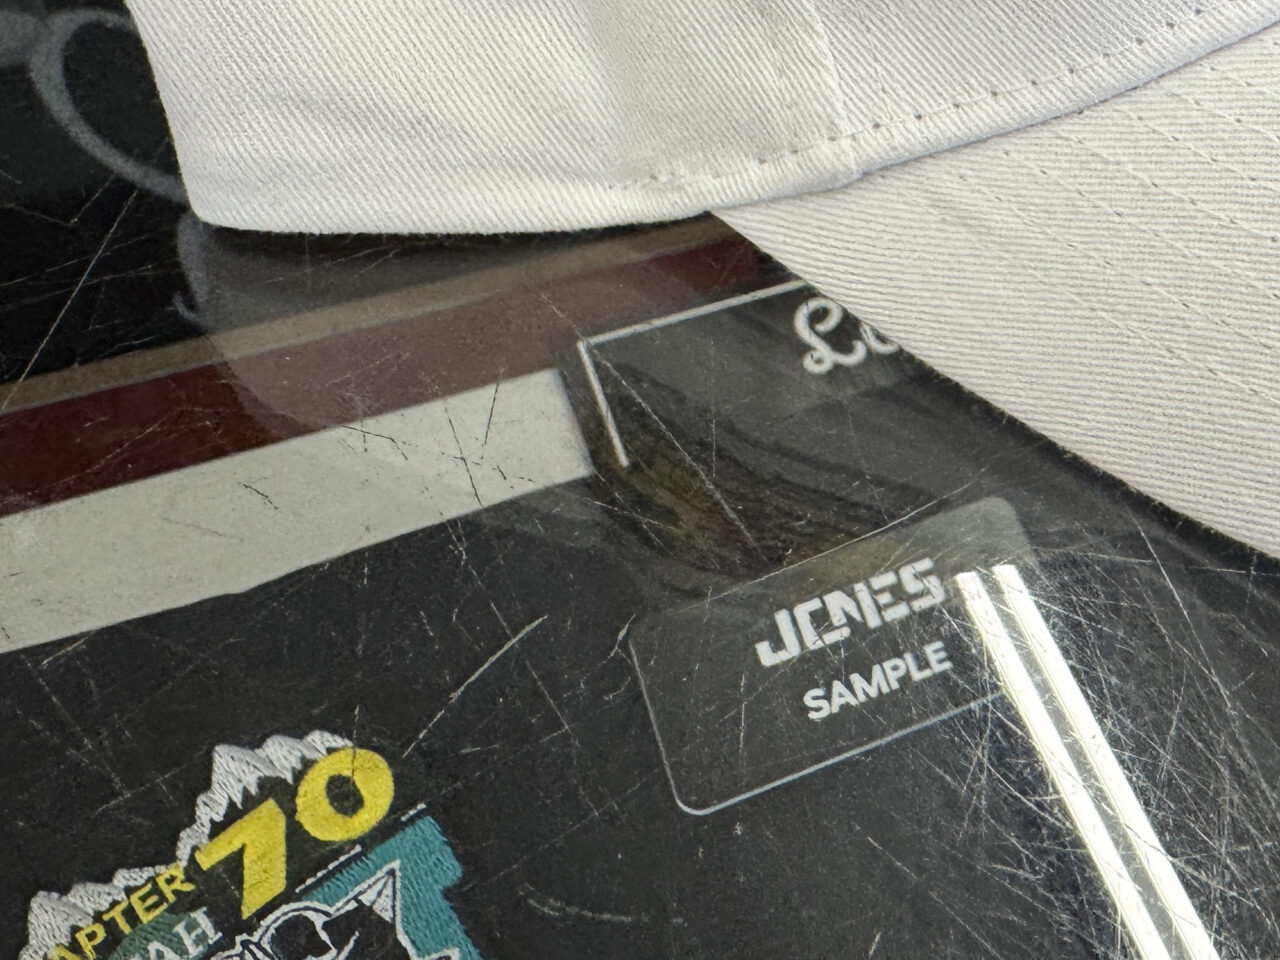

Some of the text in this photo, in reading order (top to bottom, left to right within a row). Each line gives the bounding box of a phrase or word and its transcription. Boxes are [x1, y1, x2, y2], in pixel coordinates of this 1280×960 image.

[755, 558, 946, 667] JONES
[803, 641, 953, 721] SAMPLE
[195, 747, 395, 920] 70
[132, 906, 223, 960] AH
